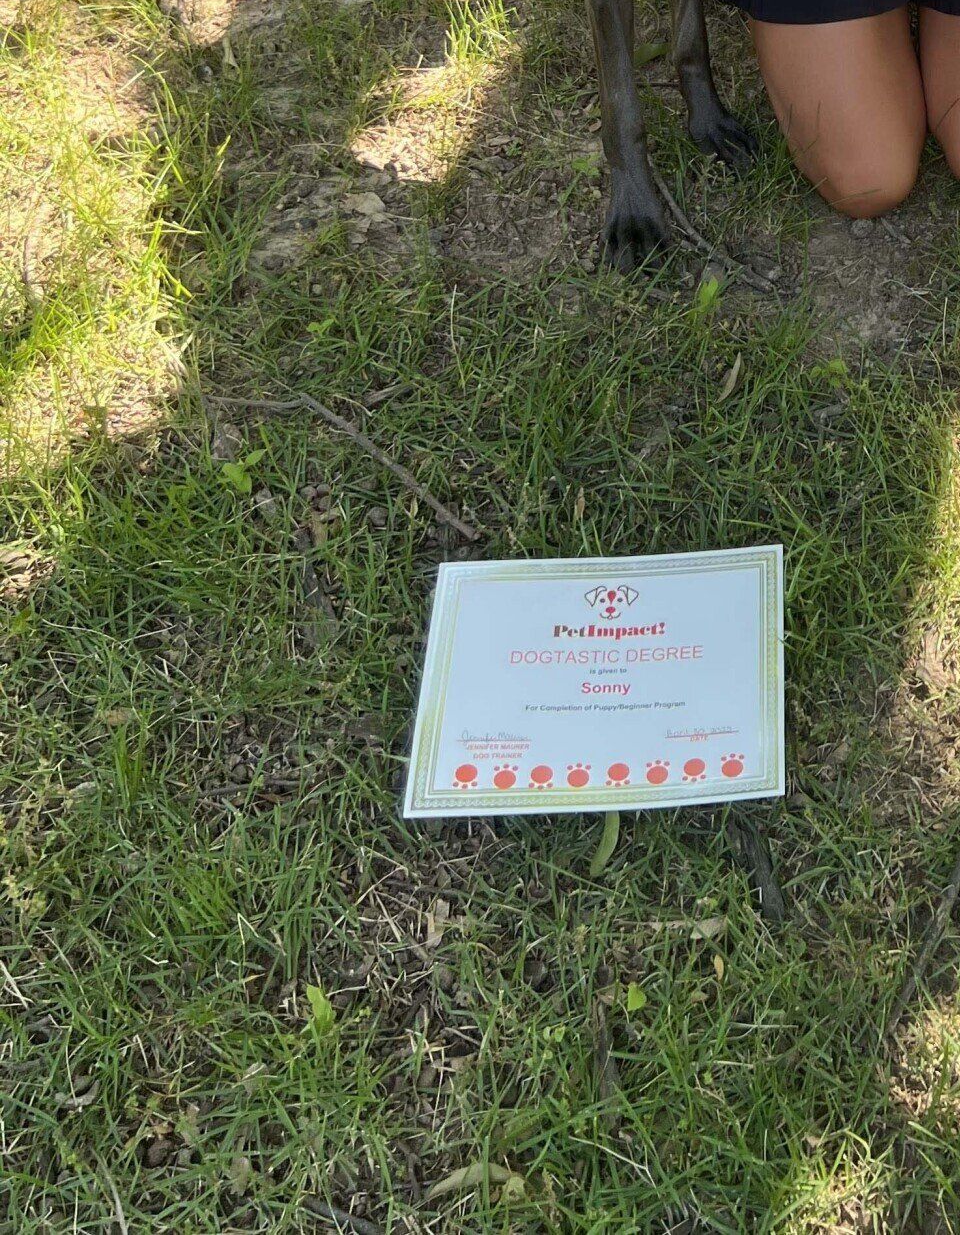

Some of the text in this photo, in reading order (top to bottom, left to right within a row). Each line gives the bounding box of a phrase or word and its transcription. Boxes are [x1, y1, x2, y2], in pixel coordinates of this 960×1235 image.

[553, 622, 666, 640] PetImpact!
[510, 644, 704, 665] DOGTASTIC DEGREE
[597, 668, 617, 676] given
[581, 682, 631, 696] Sonny
[540, 703, 582, 712] Completion
[594, 702, 652, 712] Puppy/Beginner
[654, 701, 686, 709] Program
